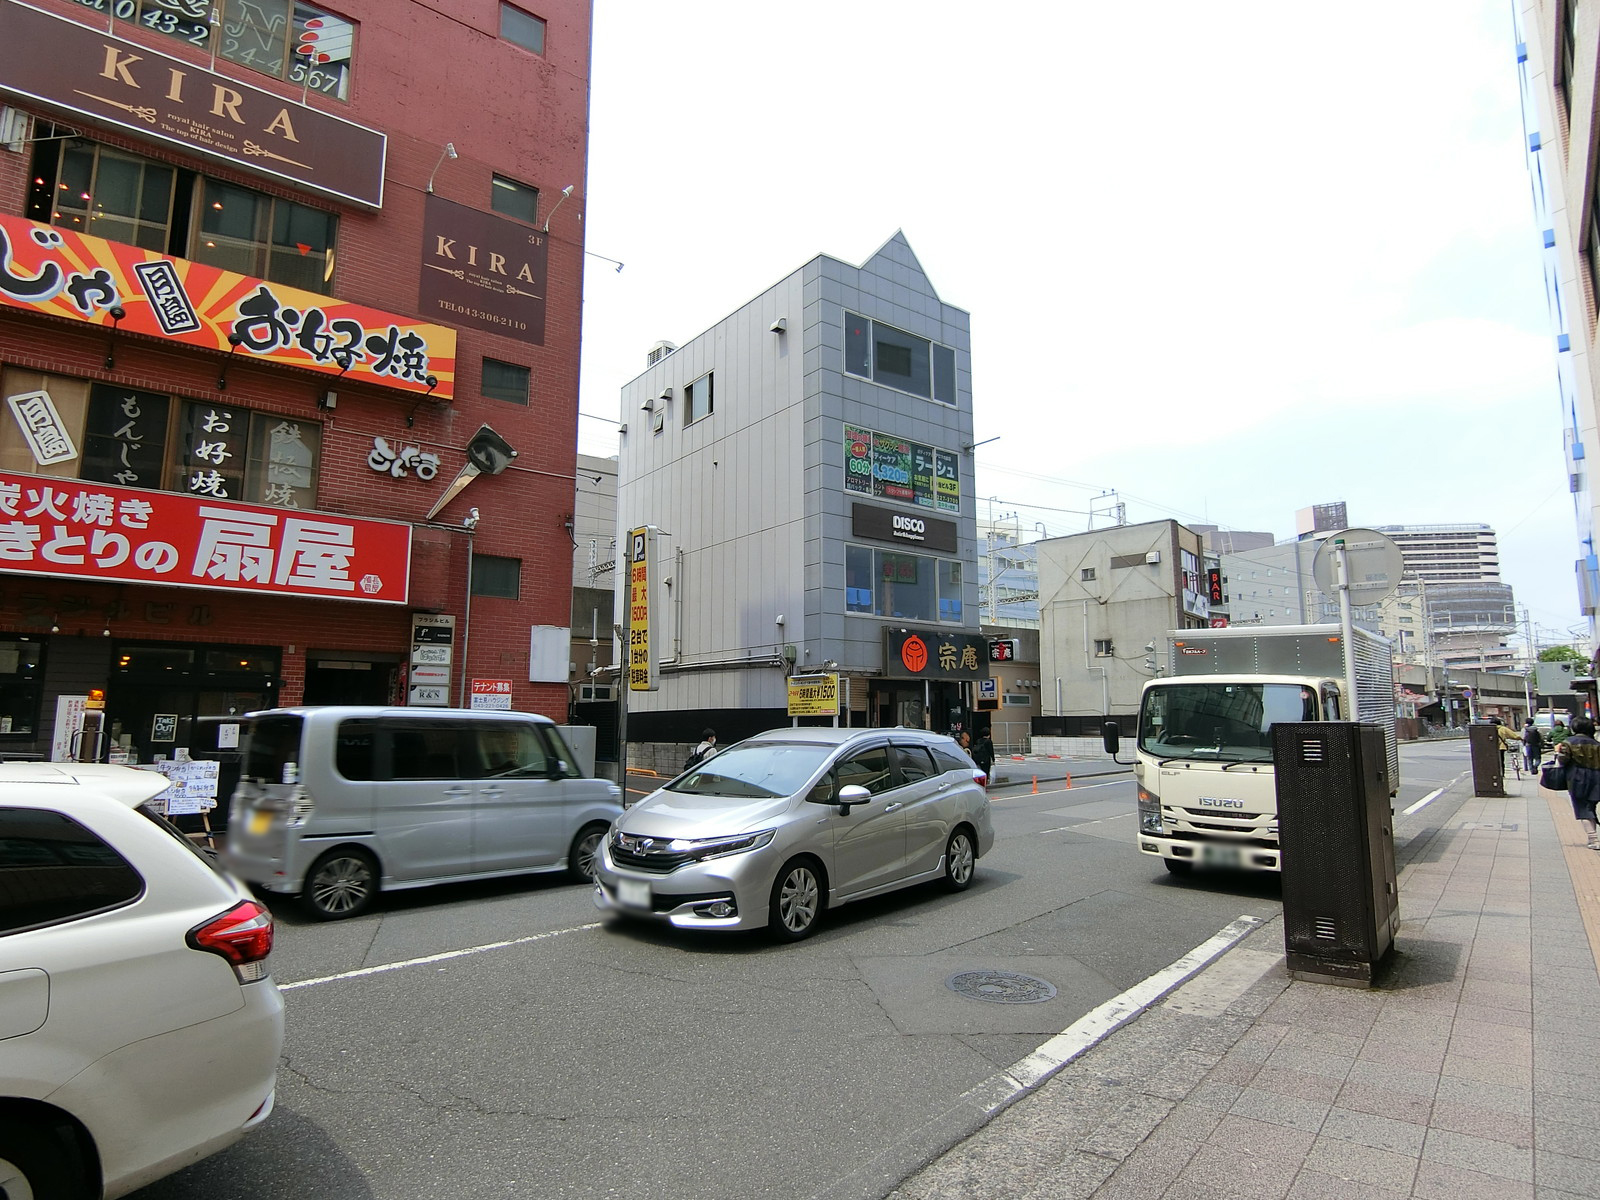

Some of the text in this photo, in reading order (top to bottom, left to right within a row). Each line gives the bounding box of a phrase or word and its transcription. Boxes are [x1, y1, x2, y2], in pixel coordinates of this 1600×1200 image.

[99, 44, 300, 143] KIRA
[160, 122, 176, 133] The
[176, 128, 189, 137] top
[200, 136, 214, 145] hair
[214, 141, 238, 153] design
[168, 113, 235, 139] royal hair salon
[189, 126, 212, 138] KIRA
[528, 234, 543, 246] 3F
[435, 235, 535, 284] KIRA
[234, 285, 427, 382] お好焼
[191, 409, 232, 498] お好焼
[265, 421, 302, 509] 鉄板焼
[849, 458, 909, 484] 60分 4,320円
[915, 455, 956, 479] ラーシュ
[892, 515, 925, 533] DISCO
[0, 521, 179, 573] きとりの
[192, 506, 356, 592] 扇屋
[634, 536, 644, 561] P
[1211, 573, 1220, 600] BAR
[632, 605, 648, 621] 1500円
[631, 629, 648, 645] 2台で
[938, 641, 979, 672] 宗庵
[474, 682, 510, 693] テナント募集
[981, 679, 994, 691] P
[155, 723, 175, 732] OUT
[156, 717, 175, 725] TAKE
[1198, 796, 1244, 808] ISUZU
